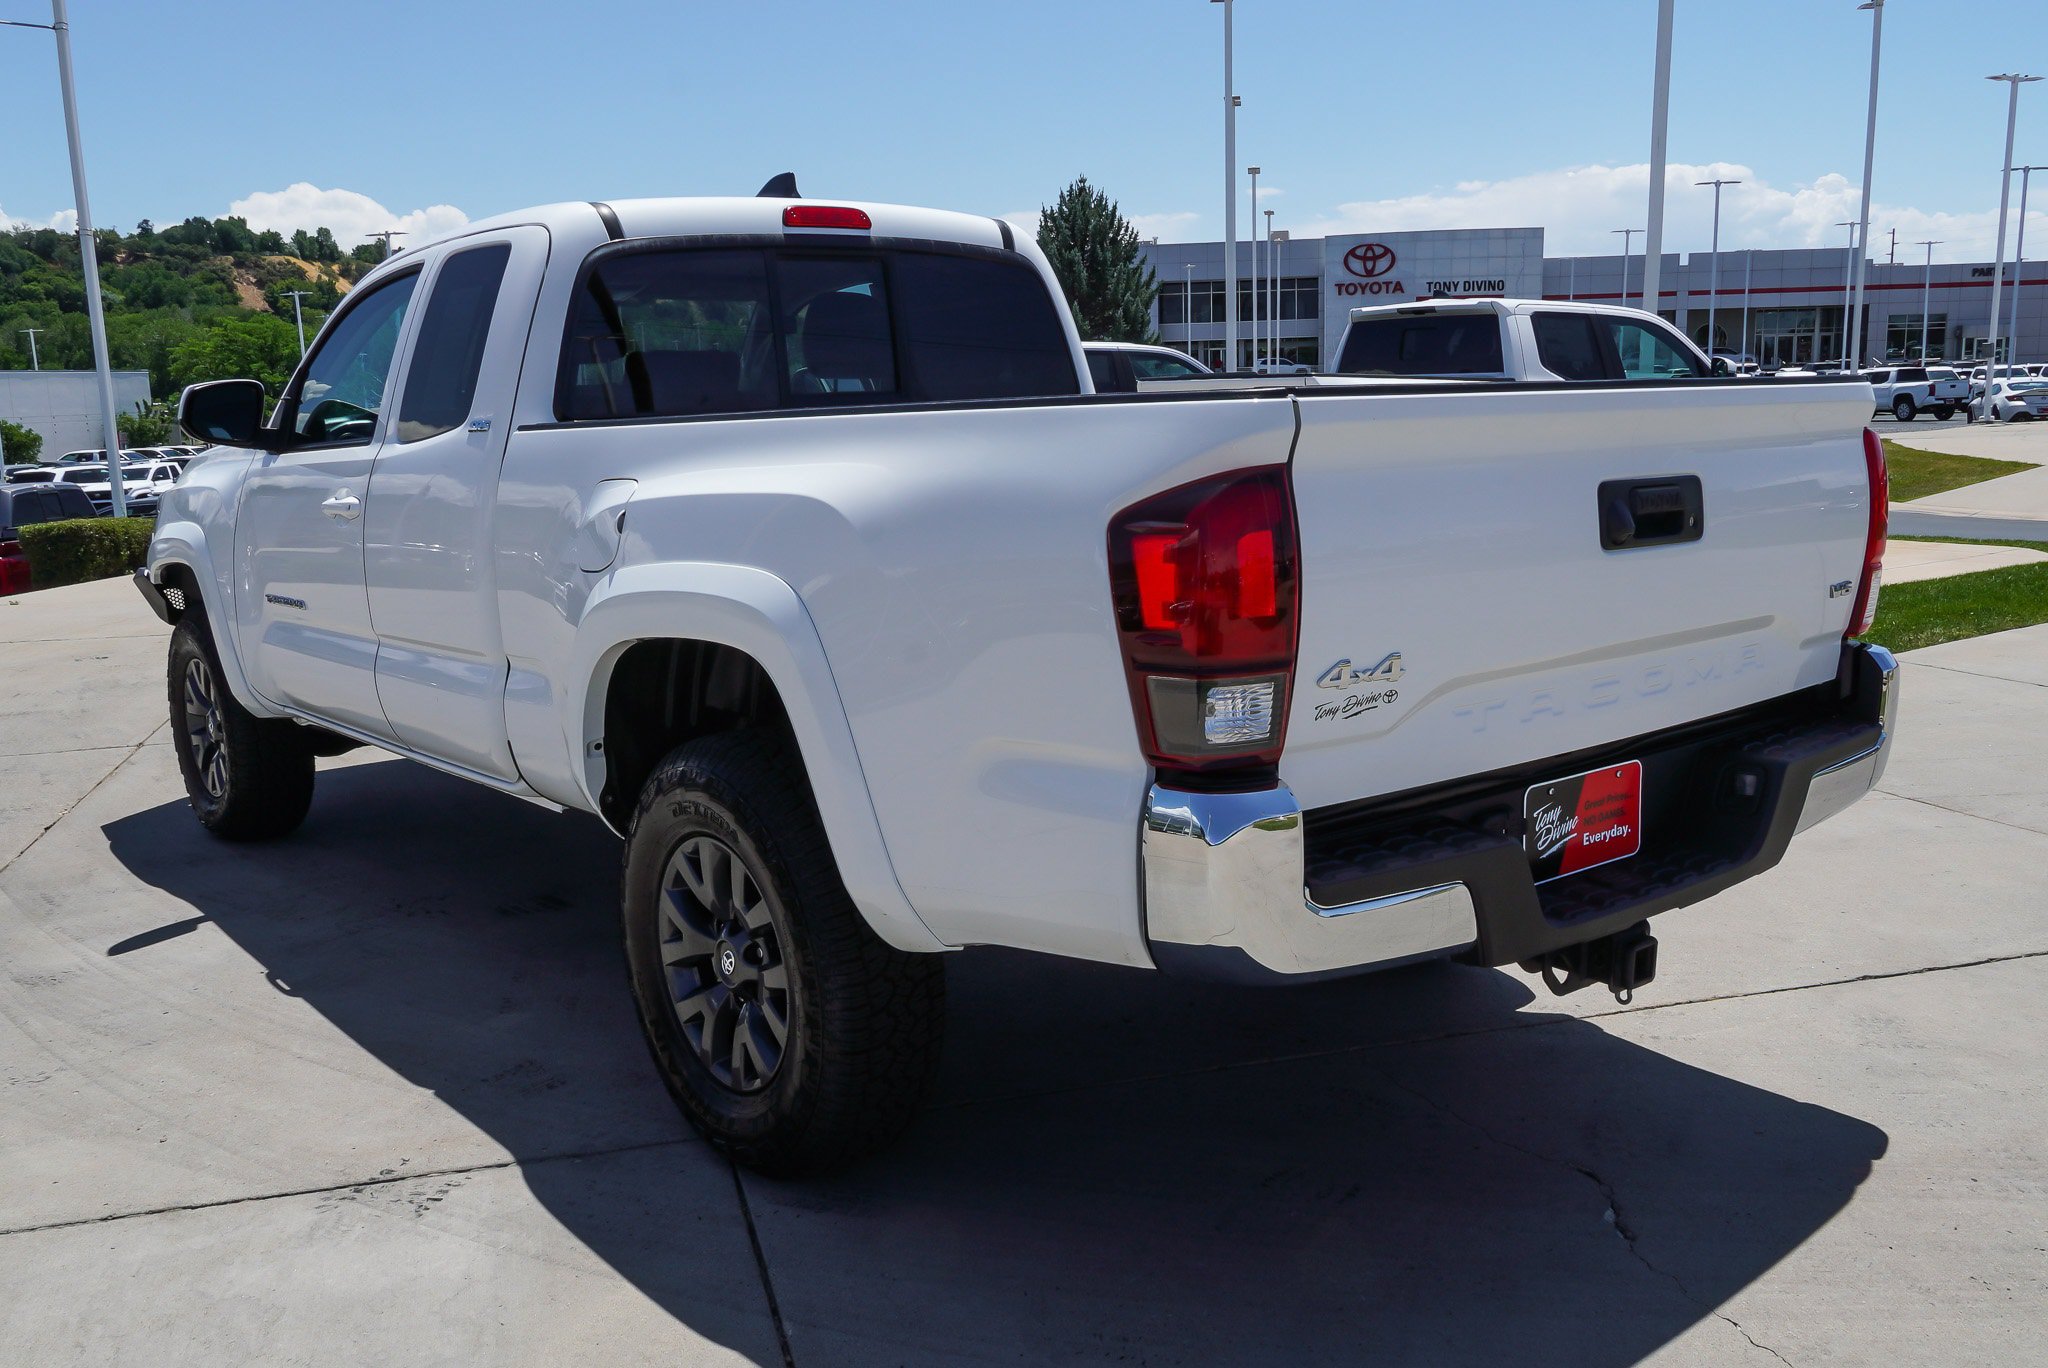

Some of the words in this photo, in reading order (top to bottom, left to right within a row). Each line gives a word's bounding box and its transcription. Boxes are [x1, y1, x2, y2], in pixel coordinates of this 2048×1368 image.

[1335, 281, 1405, 296] TOYOTA
[1426, 281, 1460, 293] TONY
[1463, 280, 1505, 292] DIVINO
[1452, 642, 1764, 733] TACOMA
[1314, 701, 1341, 721] Tony
[1342, 691, 1382, 713] Divino
[1533, 802, 1562, 832] Tony
[1533, 816, 1580, 850] Divino
[1583, 824, 1631, 846] Everyday.
